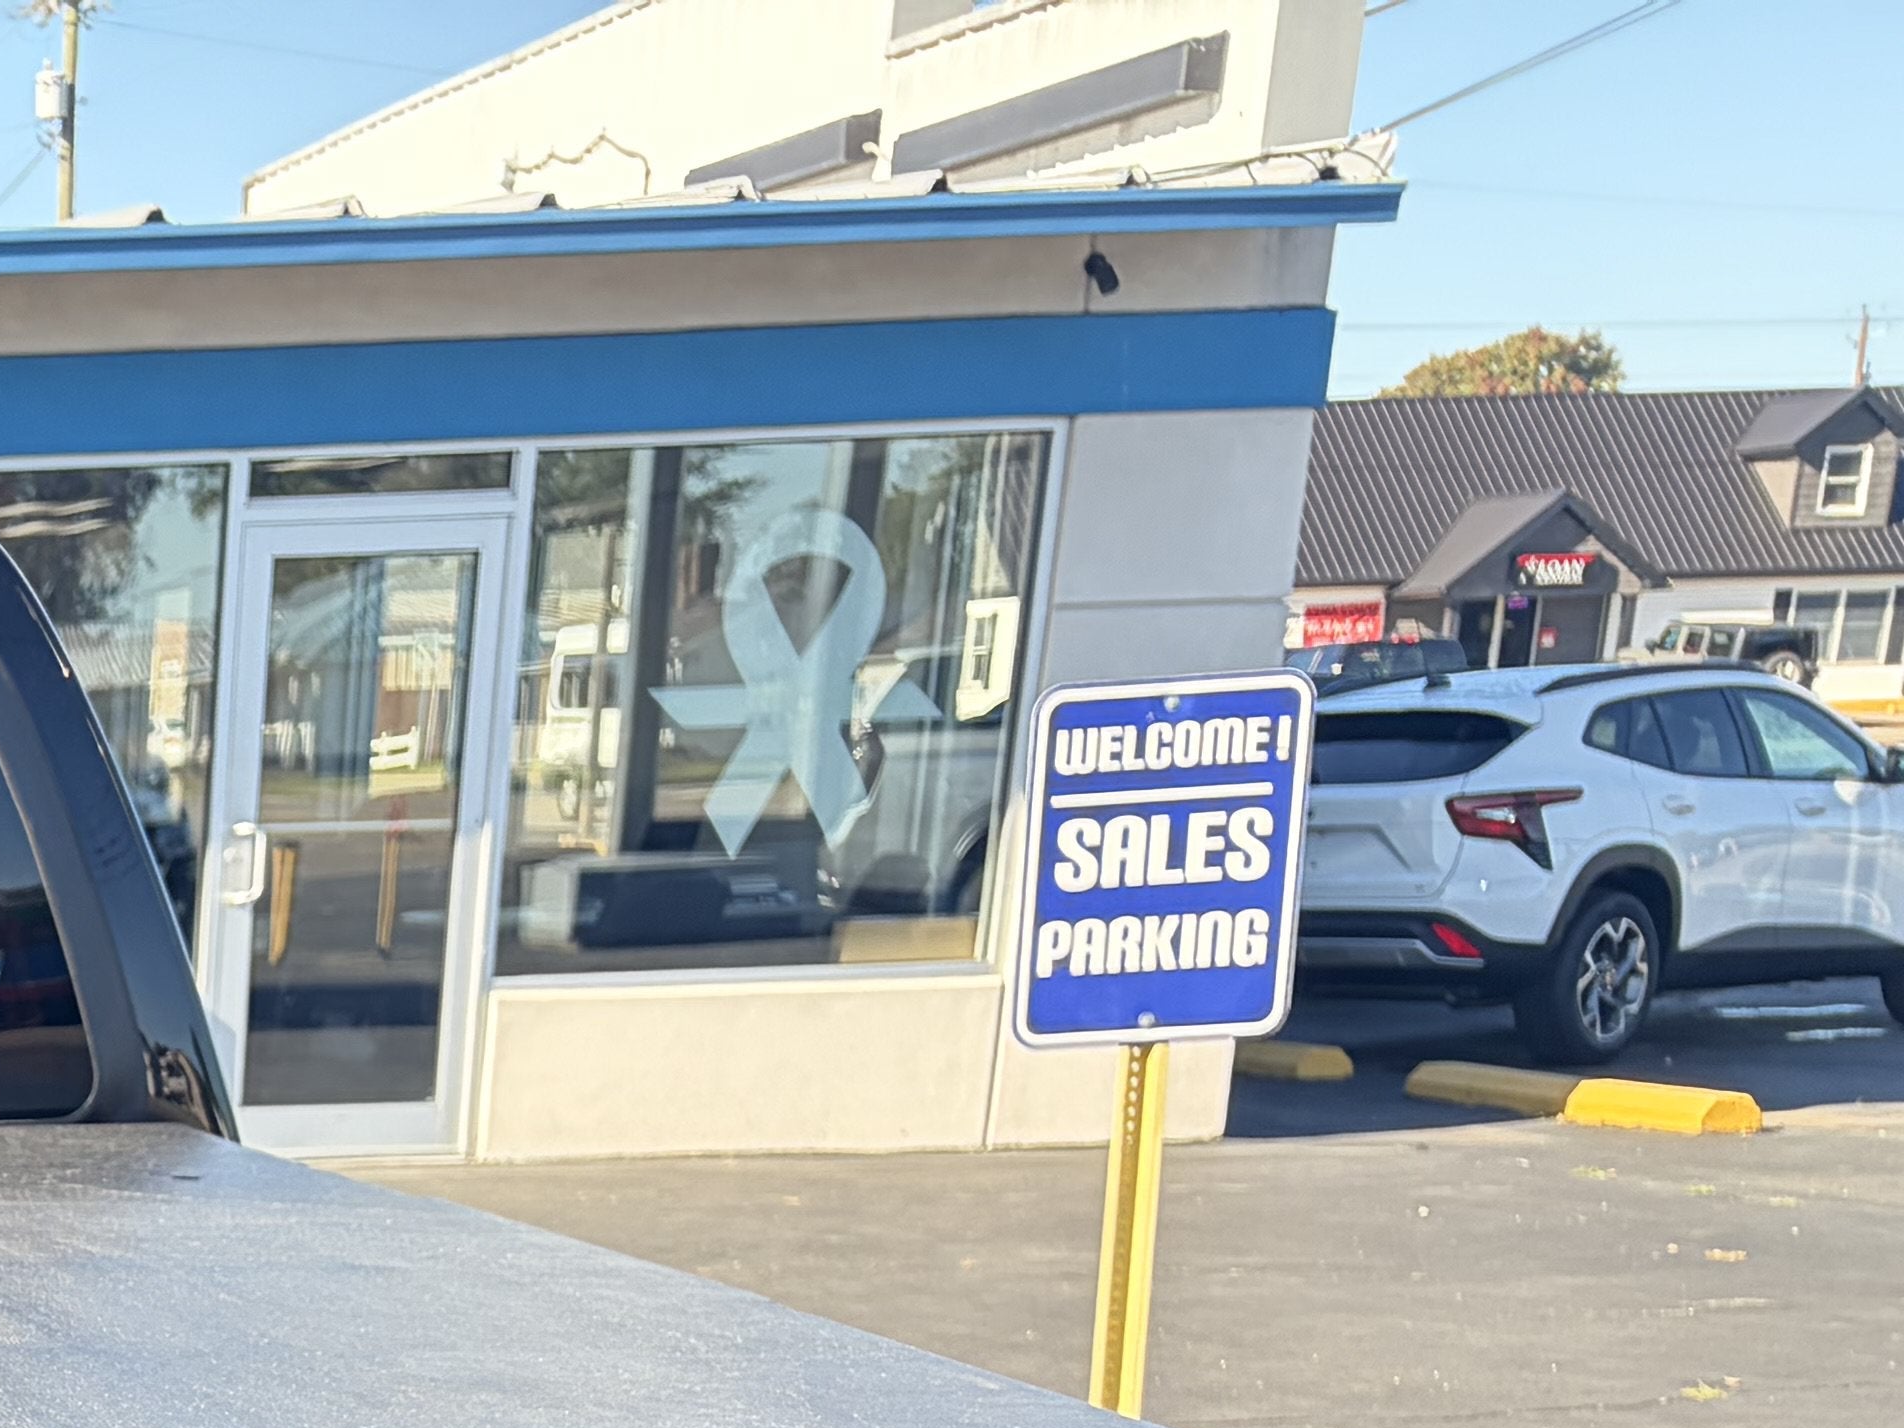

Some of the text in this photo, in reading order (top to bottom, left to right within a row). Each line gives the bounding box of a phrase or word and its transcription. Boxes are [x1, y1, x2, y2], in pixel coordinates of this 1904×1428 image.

[1054, 715, 1292, 776] WELCOME!
[1054, 807, 1274, 893] SALES
[1036, 908, 1270, 979] PARKING
